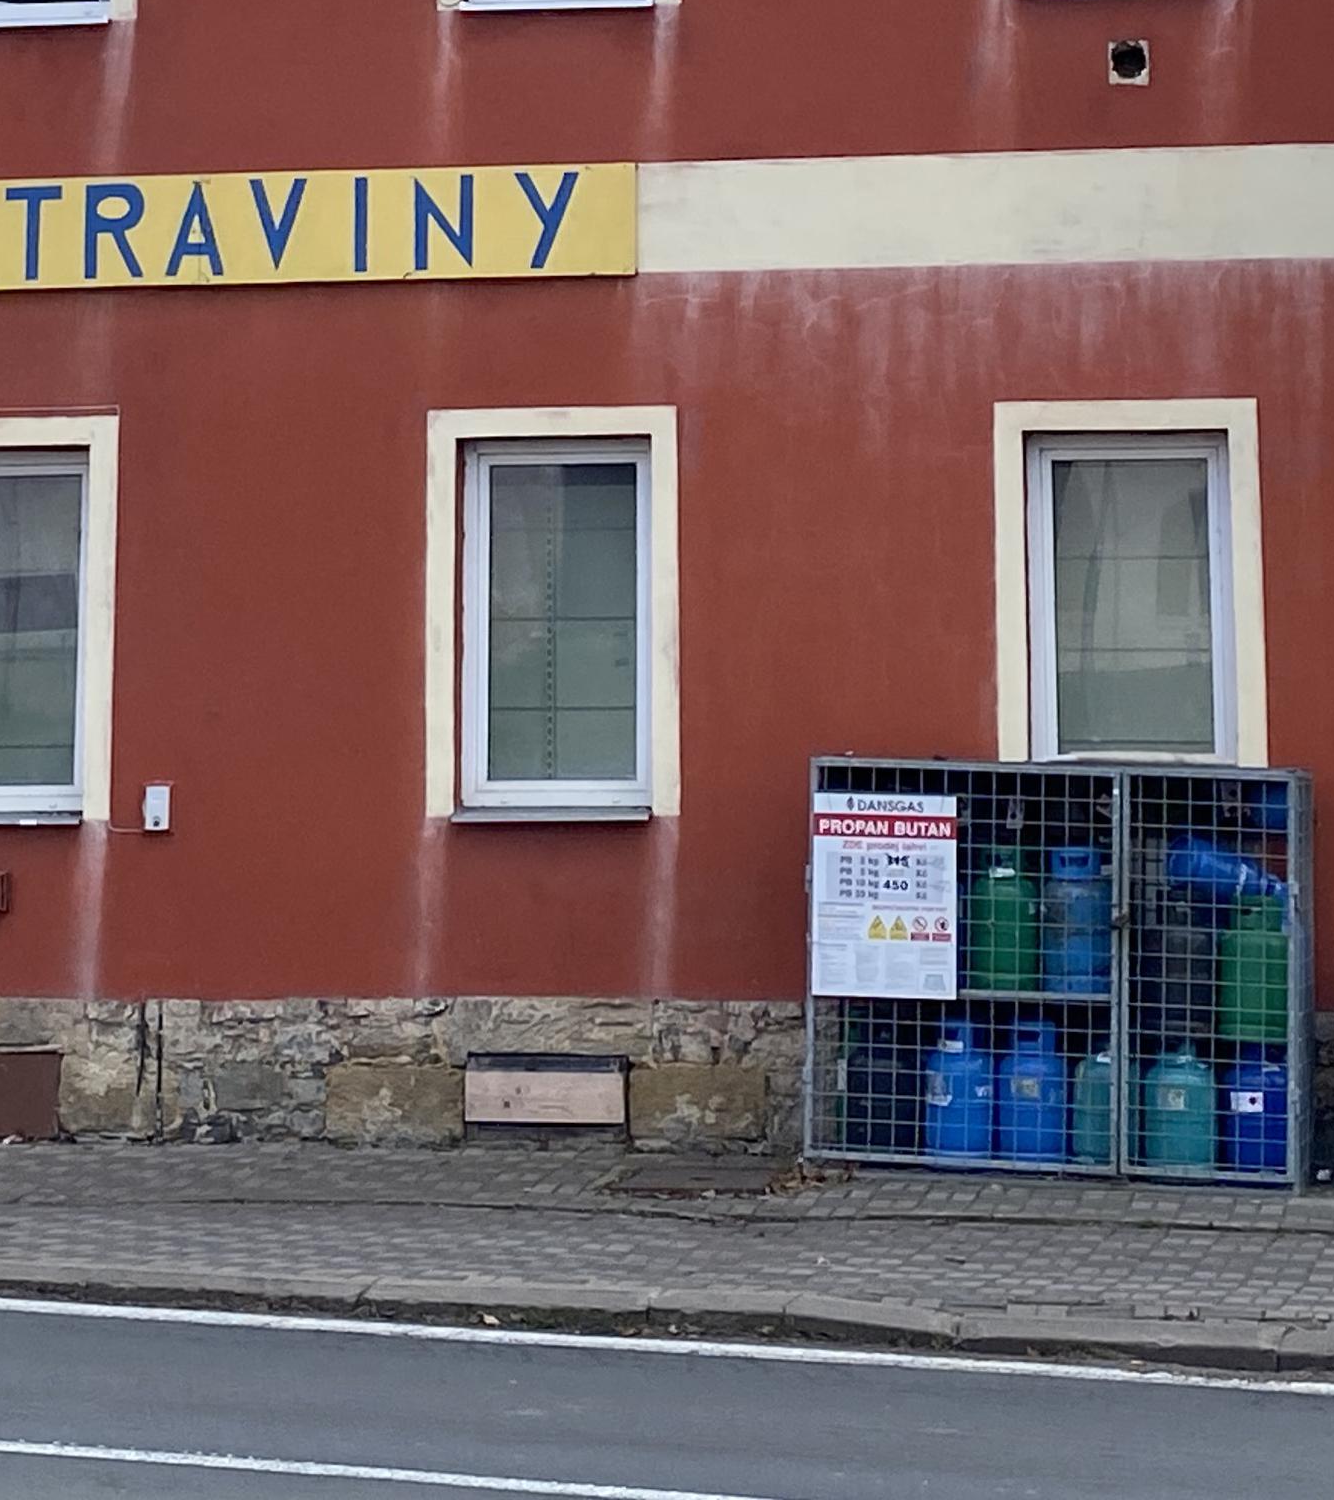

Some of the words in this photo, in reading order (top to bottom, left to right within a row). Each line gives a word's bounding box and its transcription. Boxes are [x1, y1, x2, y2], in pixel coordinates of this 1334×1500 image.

[857, 799, 924, 813] DANSGAS
[819, 818, 889, 836] PROPAN
[893, 821, 951, 837] BUTAN
[883, 879, 909, 891] 450
